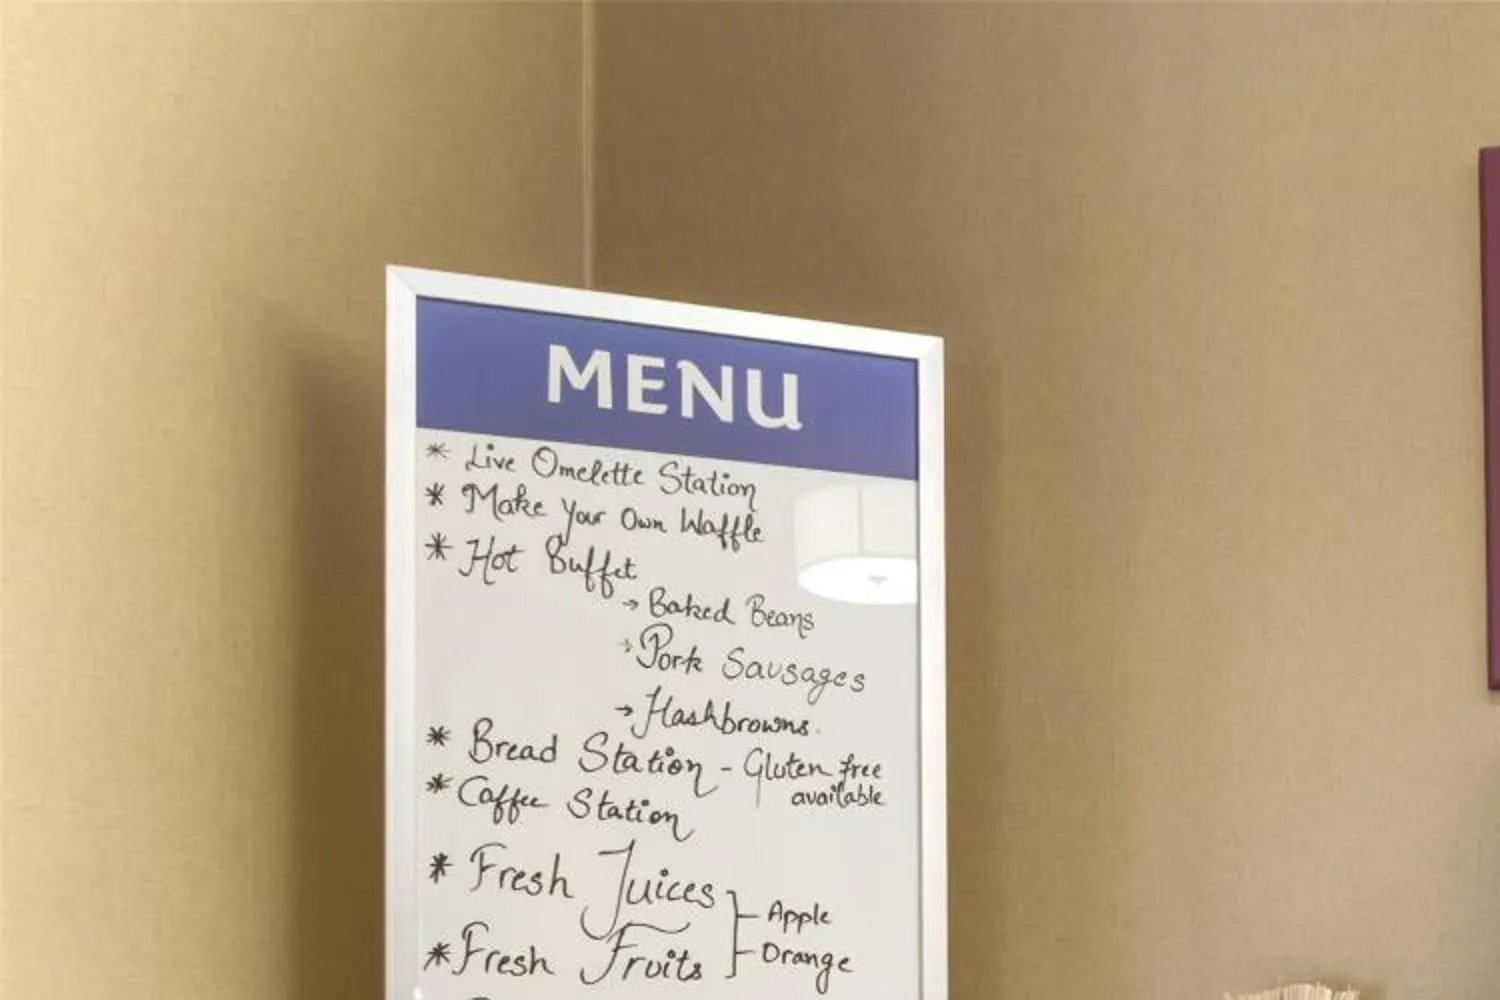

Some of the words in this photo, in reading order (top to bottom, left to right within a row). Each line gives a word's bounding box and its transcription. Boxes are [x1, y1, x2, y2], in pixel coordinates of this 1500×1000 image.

[547, 343, 803, 431] MENU
[465, 443, 515, 472] Live
[532, 446, 645, 486] Omelette
[659, 460, 757, 512] Station
[461, 483, 546, 521] Make
[561, 498, 606, 546] Your
[621, 507, 668, 534] Own
[681, 507, 765, 551] Waffle
[458, 535, 526, 585] Hot
[545, 534, 638, 599] Buffet
[649, 587, 736, 625] Baked
[745, 594, 815, 639] Beans
[636, 623, 703, 674] Pork
[721, 647, 865, 705] Sausages
[468, 717, 558, 764] Bread
[577, 731, 719, 798] Station
[743, 747, 833, 809] Gluten
[839, 753, 882, 782] free
[791, 783, 885, 808] available
[457, 775, 550, 824] Coffee
[567, 787, 695, 842] Station
[468, 842, 574, 899] Fresh
[579, 839, 716, 941] Juices
[767, 900, 832, 934] Apple
[451, 921, 554, 976] Fresh
[579, 921, 704, 985] Fruits
[761, 942, 853, 995] Orange
